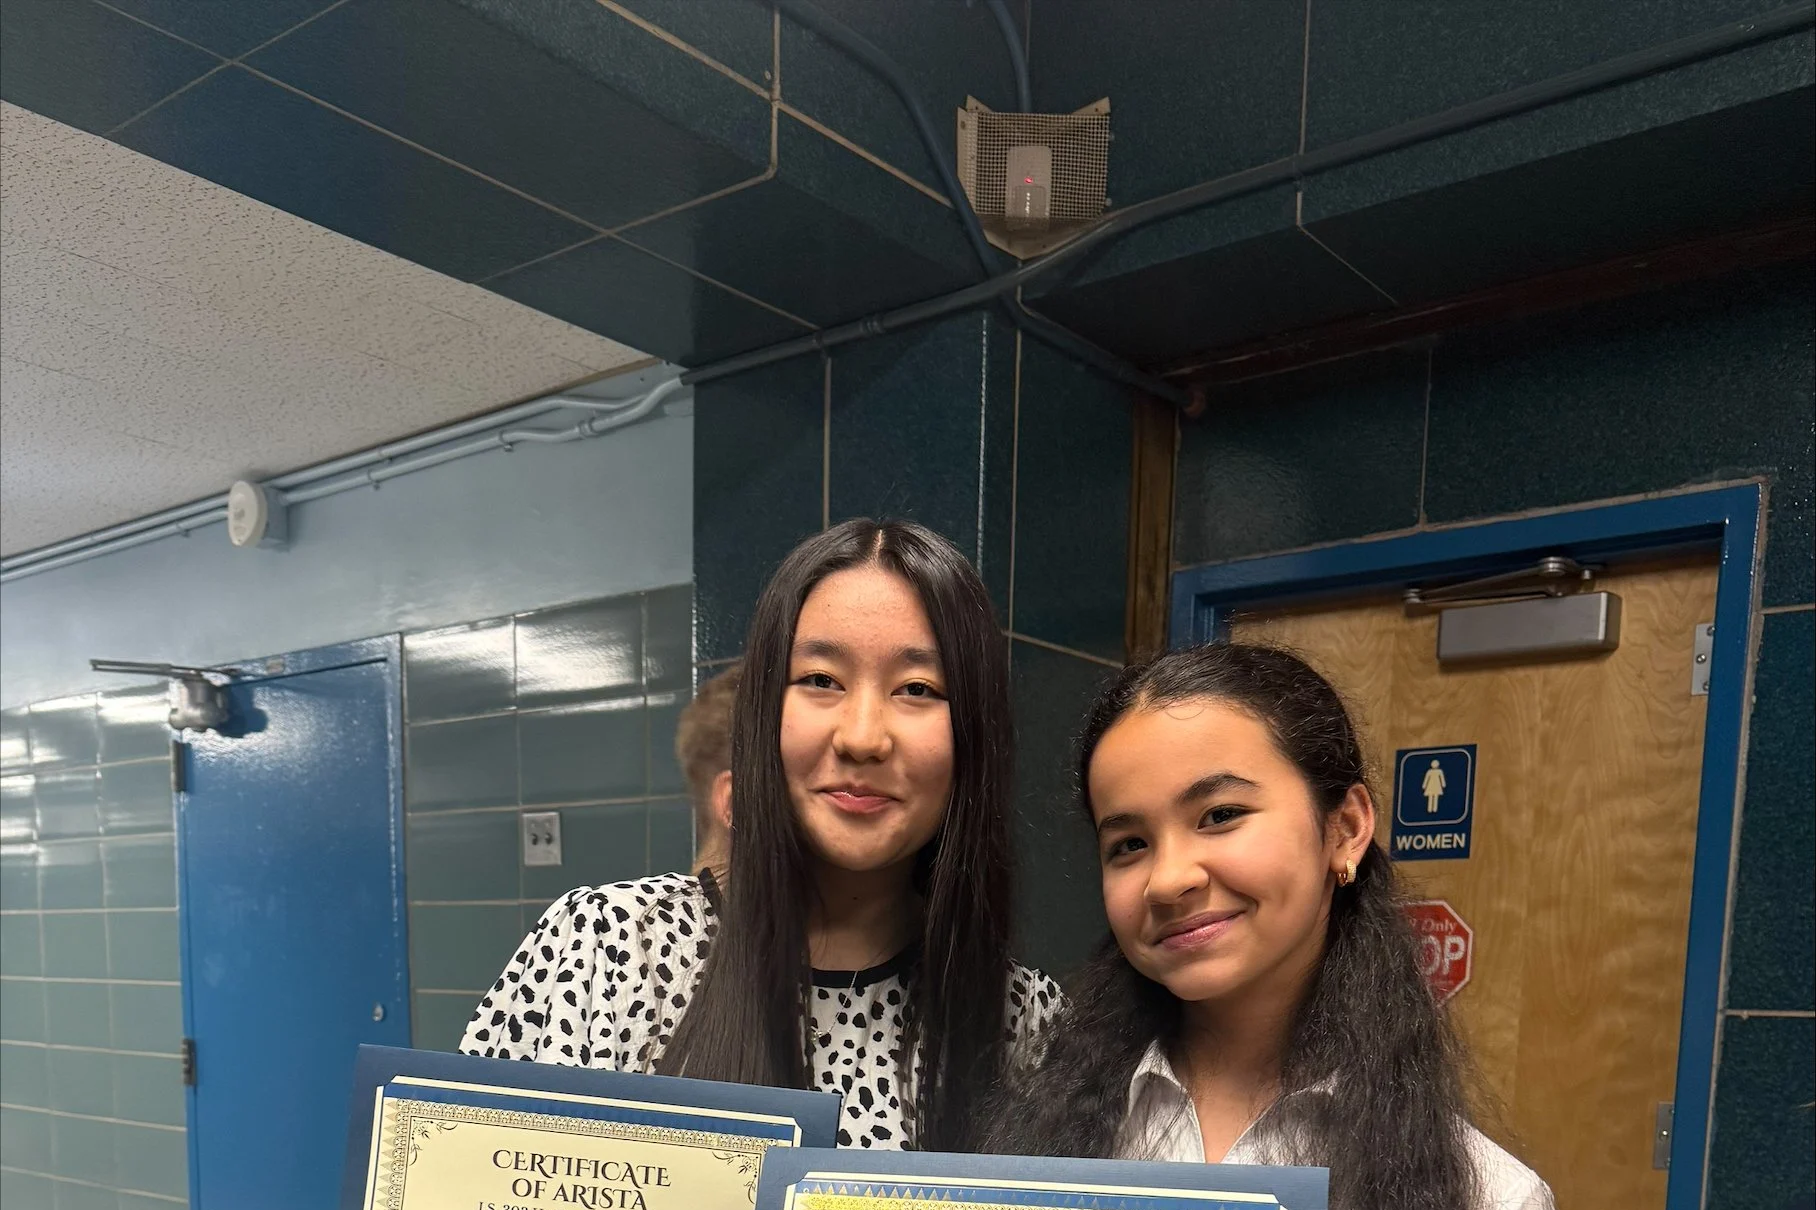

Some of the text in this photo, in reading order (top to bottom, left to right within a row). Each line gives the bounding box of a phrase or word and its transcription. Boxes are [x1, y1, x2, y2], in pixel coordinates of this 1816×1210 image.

[1396, 833, 1466, 850] WOMEN
[1421, 918, 1456, 935] Only
[1419, 934, 1465, 976] OP
[493, 1150, 672, 1189] CERTIFICATE
[512, 1178, 547, 1199] OF
